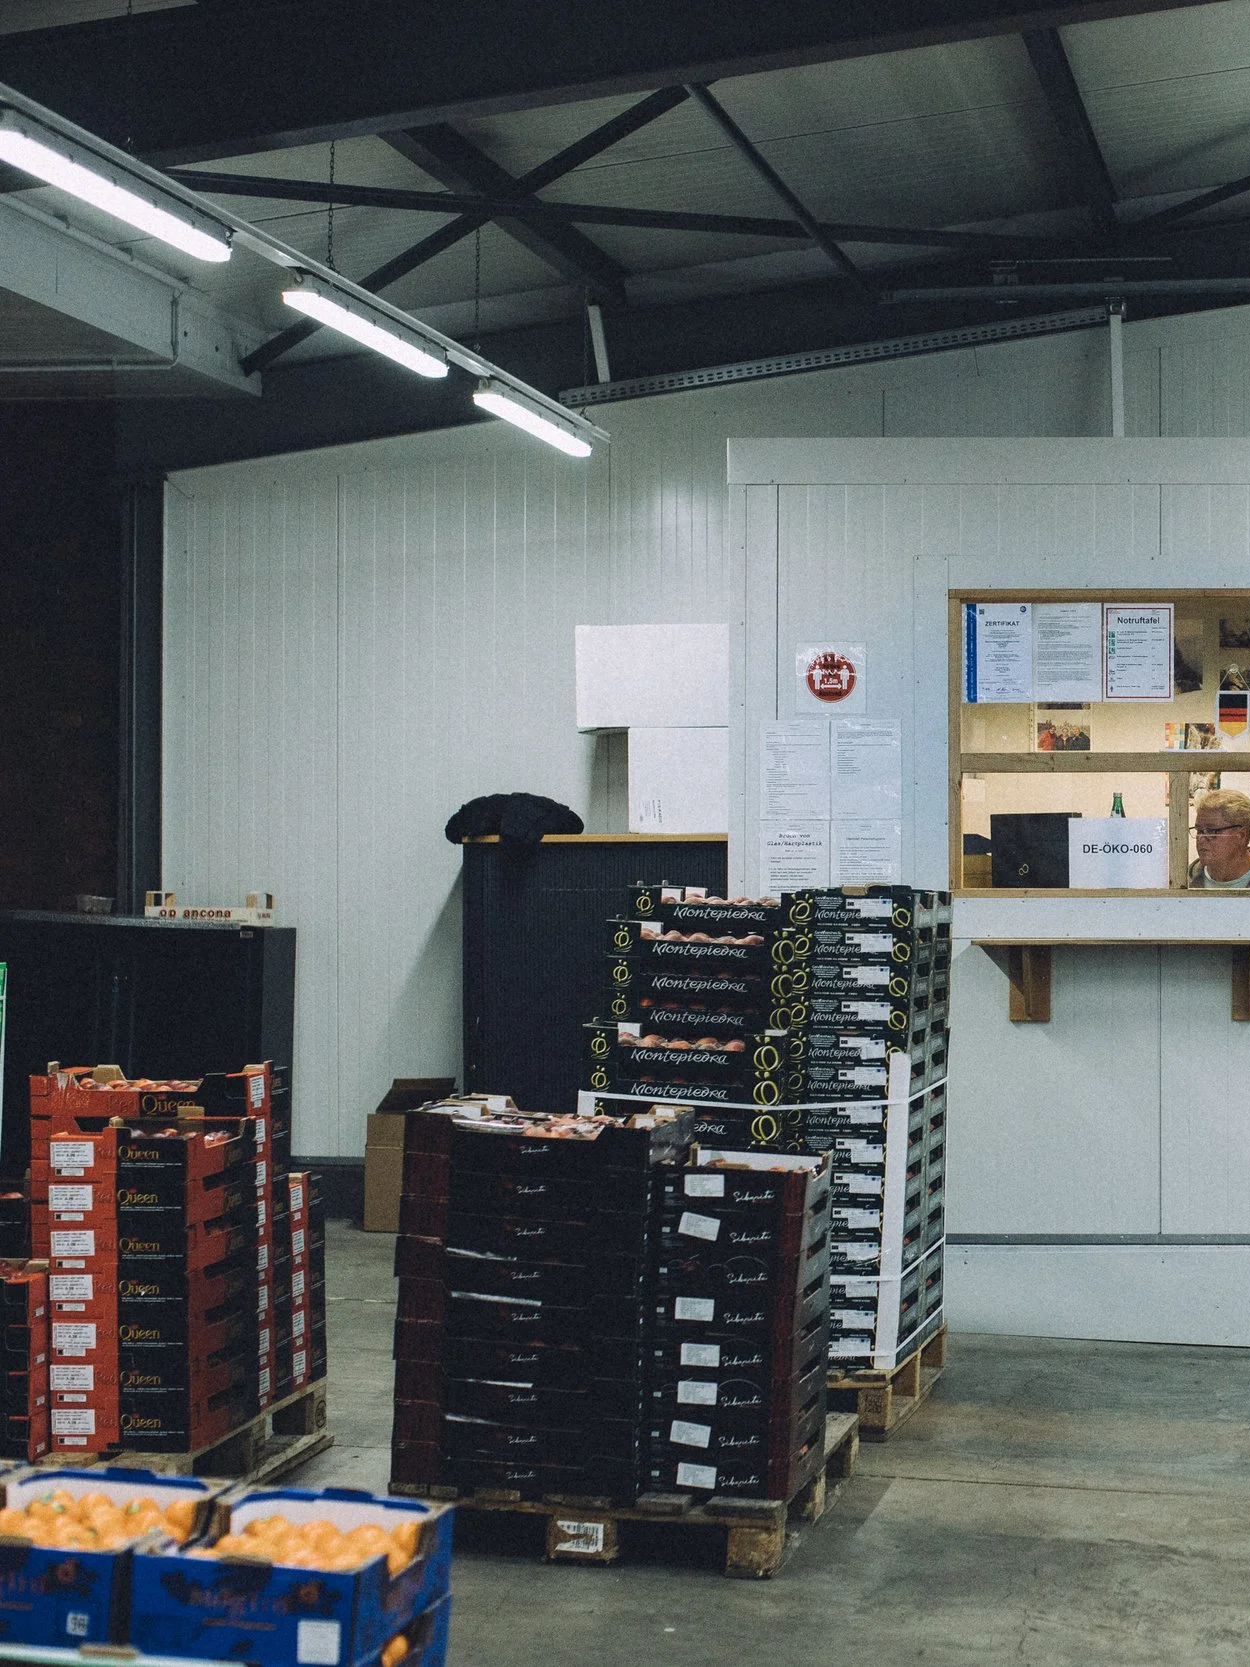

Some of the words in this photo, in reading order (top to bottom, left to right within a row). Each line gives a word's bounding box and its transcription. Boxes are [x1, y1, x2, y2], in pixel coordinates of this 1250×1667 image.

[1117, 616, 1160, 625] Notruftafel
[1083, 841, 1153, 855] DE-ÖKO-060
[674, 906, 767, 922] Montepiedra
[652, 942, 749, 959] Montepiedra
[651, 976, 747, 993] Montepiedra
[650, 1010, 745, 1026] Montepiedra
[630, 1049, 730, 1066] Montepiedra
[631, 1082, 729, 1100] Montepiedra
[118, 1145, 159, 1161] Queen
[117, 1189, 158, 1205] Queen
[119, 1237, 160, 1254] Queen
[119, 1280, 160, 1296] Queen
[119, 1325, 160, 1341] Queen
[120, 1371, 161, 1386] Queen
[120, 1414, 161, 1430] Queen
